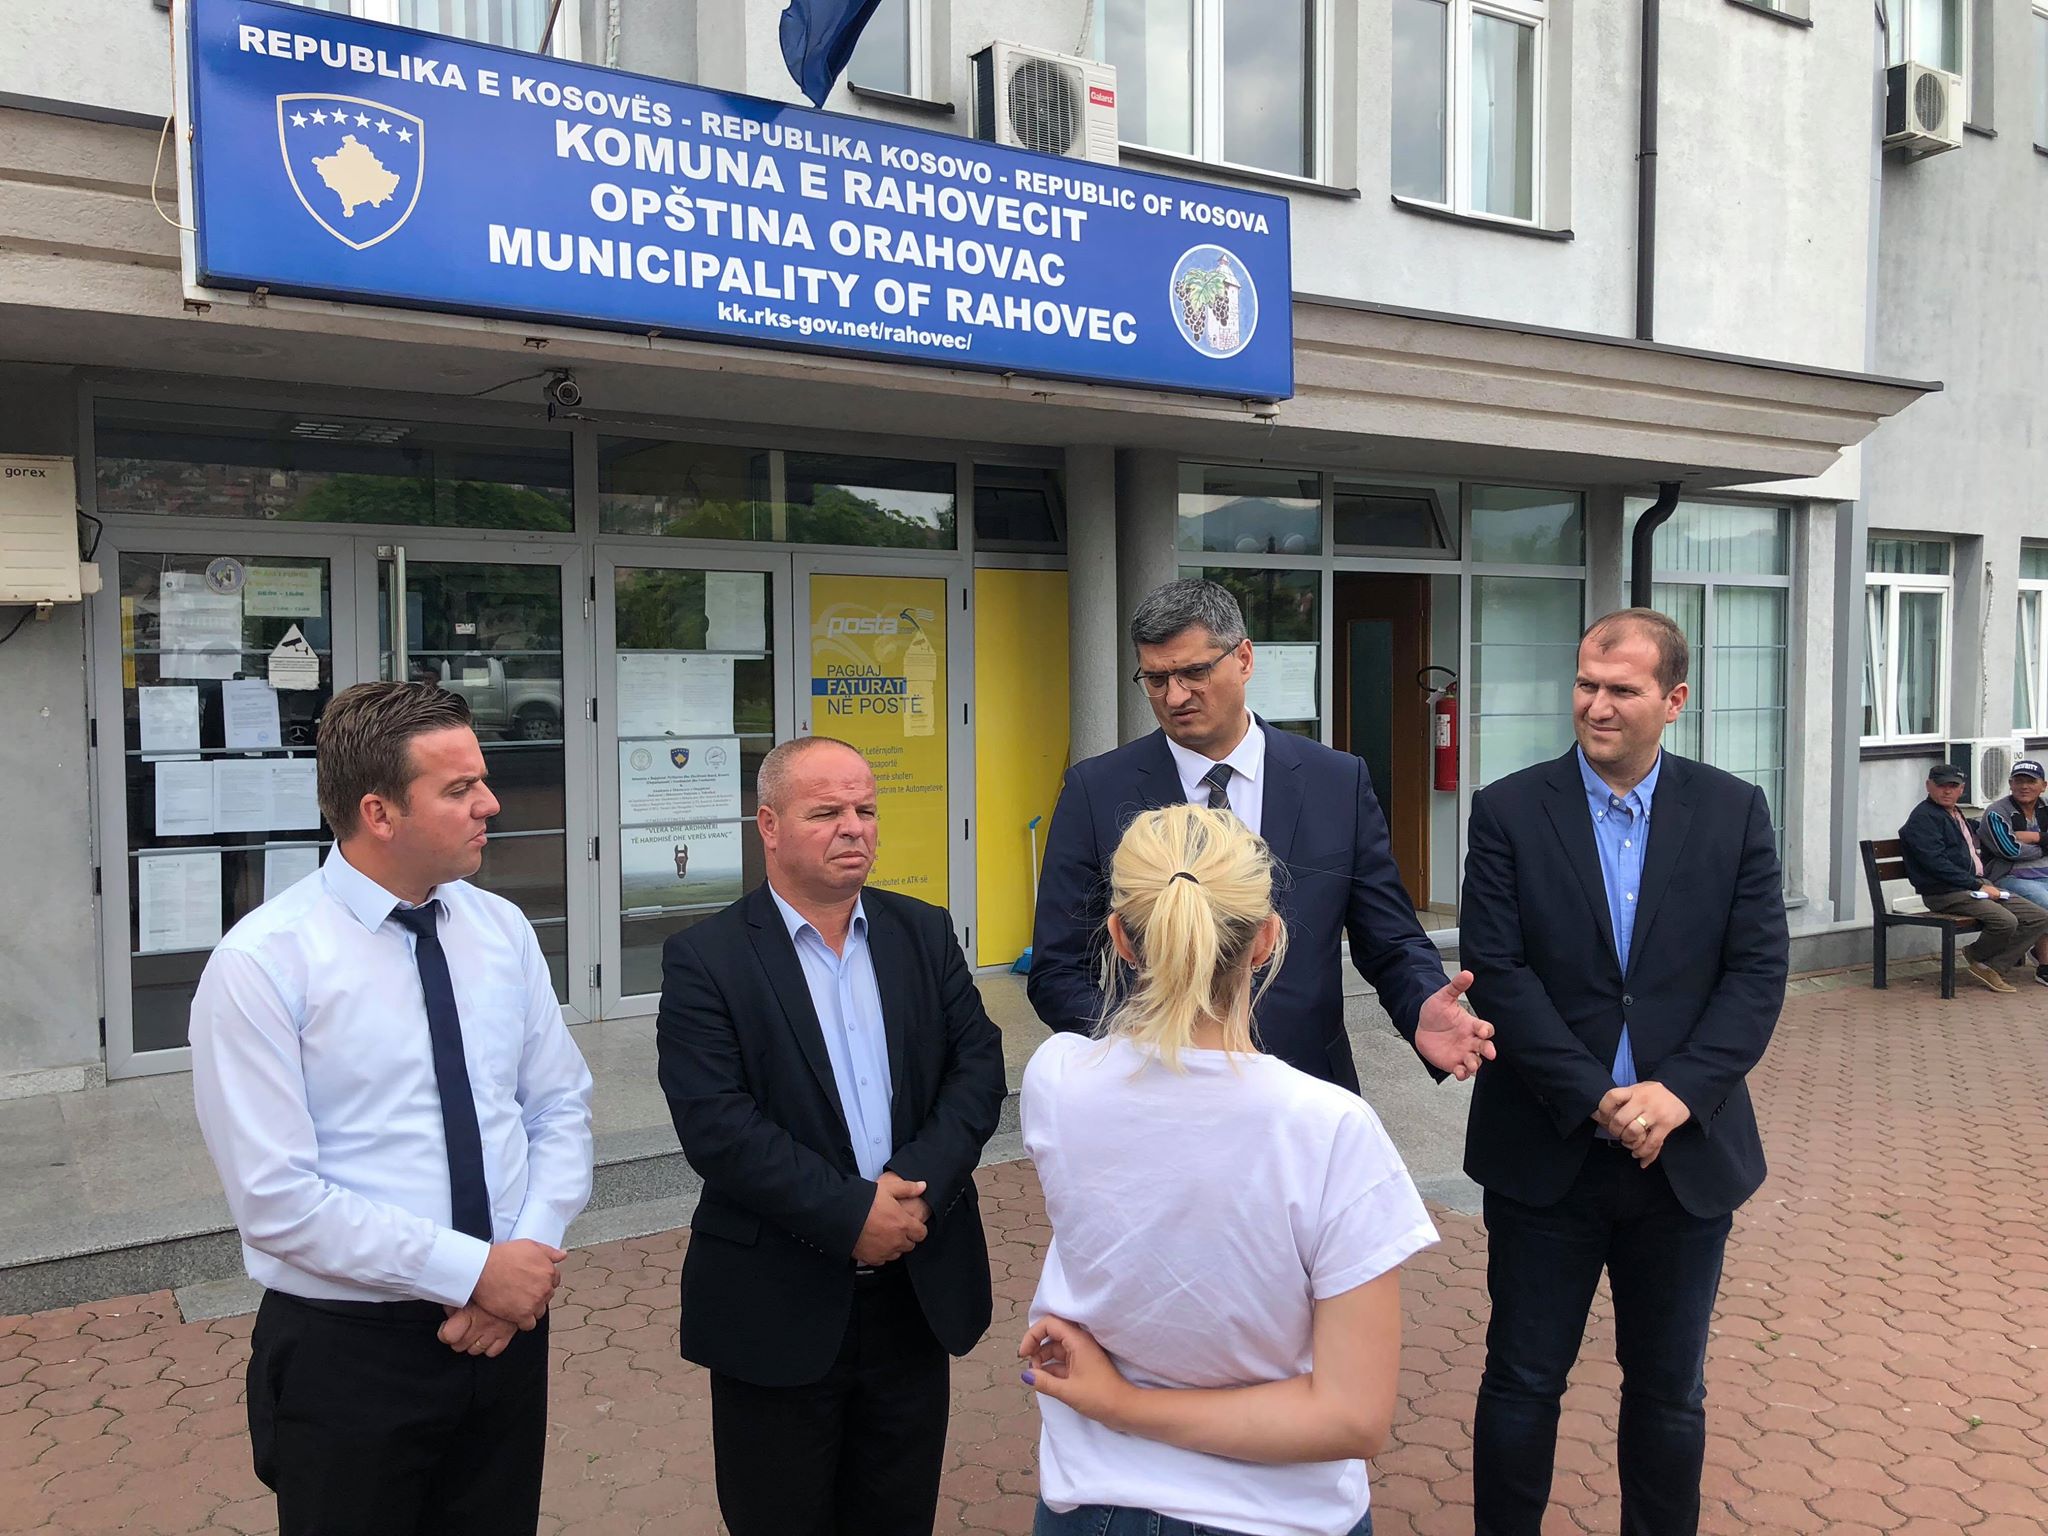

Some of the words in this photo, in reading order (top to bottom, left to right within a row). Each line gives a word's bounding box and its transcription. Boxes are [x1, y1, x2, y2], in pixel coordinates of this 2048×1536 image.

[238, 24, 467, 91] REPUBLIKA
[477, 68, 500, 97] E
[511, 75, 672, 127] KOSOVËS
[701, 111, 873, 164] REPUBLIKA
[880, 144, 992, 184] KOSOVO
[1015, 169, 1136, 211] REPUBLIC
[1142, 193, 1173, 217] OF
[1179, 199, 1270, 235] KOSOVA
[555, 118, 786, 193] KOMUNA
[799, 161, 828, 201] E
[843, 169, 1088, 242] RAHOVECIT
[590, 182, 816, 251] OPŠTINA
[829, 219, 1066, 287] ORAHOVAC
[488, 223, 860, 308] MUNICIPALITY
[874, 278, 931, 317] OF
[946, 287, 1137, 345] RAHOVEC
[717, 301, 973, 351] kk.rks-gov.net/rahovec/
[5, 467, 46, 478] gorex
[827, 617, 898, 639] posta
[827, 664, 882, 677] PAGUAJ
[827, 680, 904, 694] FATURAT
[828, 695, 853, 715] NË
[860, 694, 924, 714] POSTË
